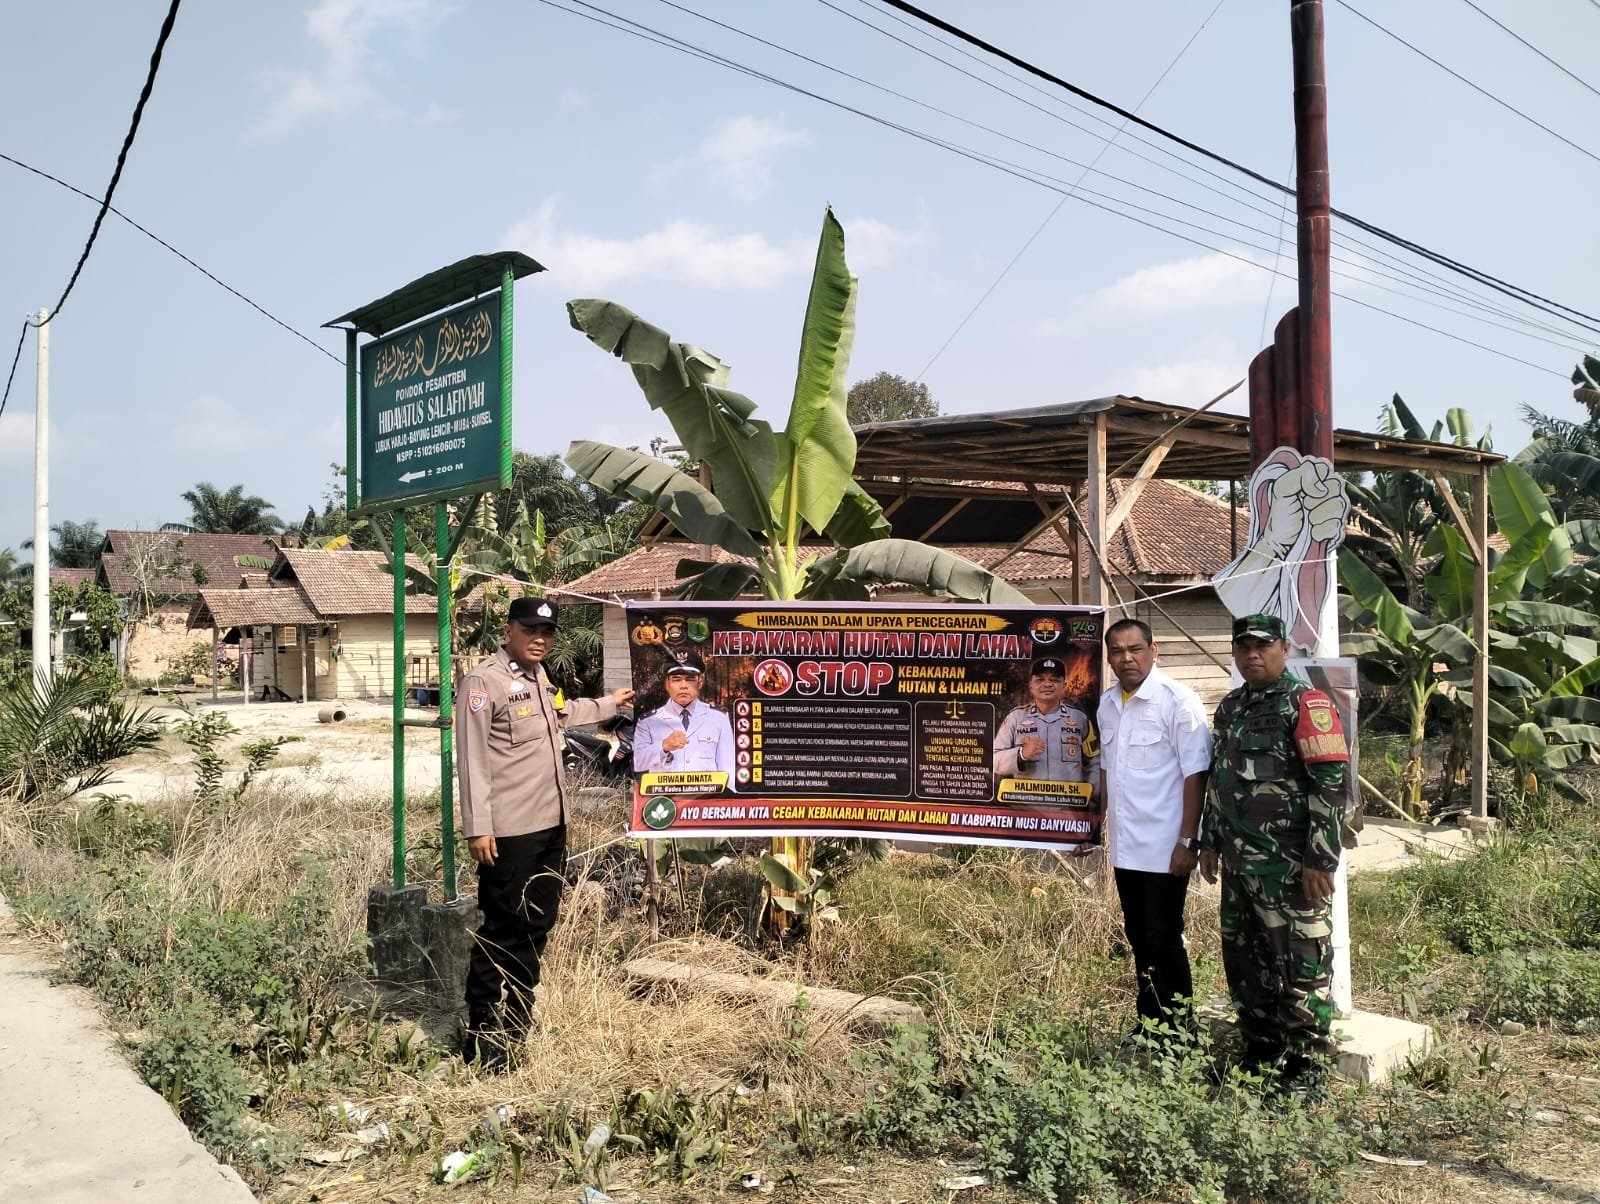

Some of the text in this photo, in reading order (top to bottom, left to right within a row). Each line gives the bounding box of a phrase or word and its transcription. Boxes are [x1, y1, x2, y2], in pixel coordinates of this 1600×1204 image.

[396, 369, 466, 401] PONDOK PESANTREN
[379, 381, 484, 434] HIDAYATUS SALAFIYYAH
[436, 465, 453, 474] 200
[757, 616, 986, 628] HIMBAUAN DALAM UPAYA PENCEGAHAN
[713, 631, 1032, 659] KEBAKARAN HUTAN DAN LAHAN
[898, 666, 965, 678] KEBAKARAN
[796, 661, 893, 696] STOP
[898, 681, 935, 693] HUTAN
[939, 681, 947, 693] &
[950, 682, 988, 694] LAHAN
[508, 692, 531, 704] HALIM
[658, 774, 712, 783] URWAN DINATA
[1015, 782, 1080, 794] HALIMUDDIN, SH.
[680, 806, 1091, 833] AYO BERSAMA KITA CEGAH KEBAKARAN HUTAN DAN LAHAN DI KABUPATEN MUSI BANYUASIN
